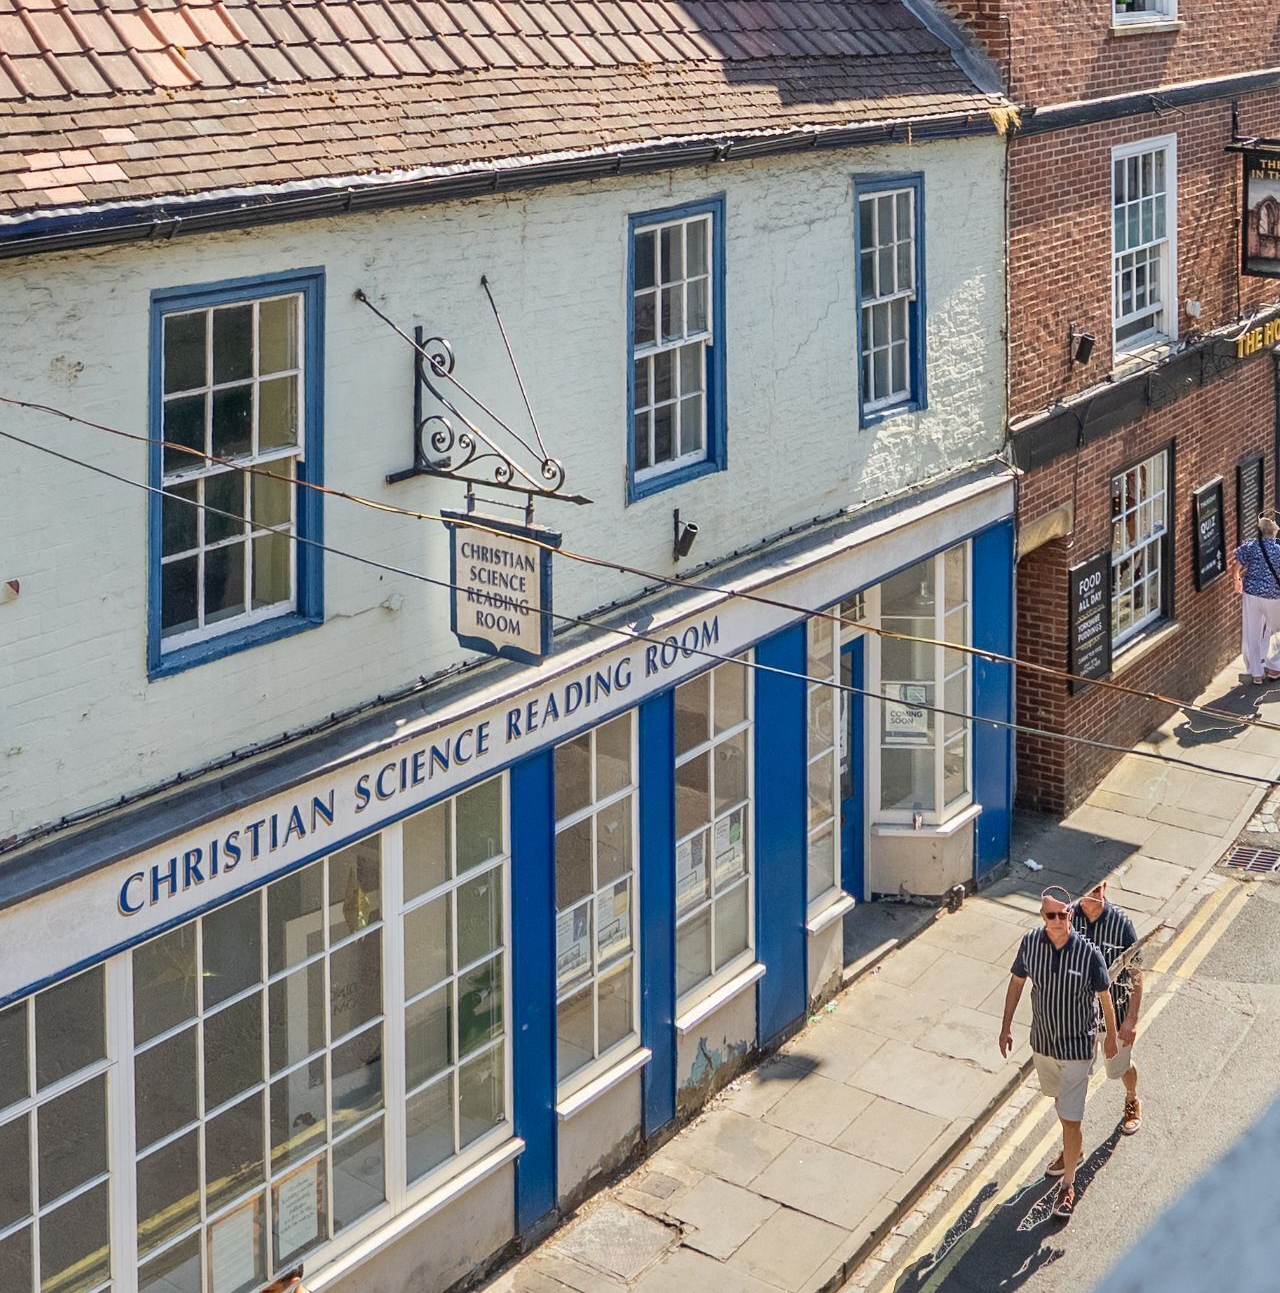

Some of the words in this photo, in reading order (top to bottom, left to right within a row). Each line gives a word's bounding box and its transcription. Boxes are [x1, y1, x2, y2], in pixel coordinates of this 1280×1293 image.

[1251, 170, 1265, 179] IN
[1236, 327, 1263, 358] THE
[1200, 515, 1216, 534] QUIZ
[461, 542, 535, 573] CHRISTIAN
[469, 566, 526, 593] SCIENCE
[1079, 572, 1101, 595] FOOD
[467, 587, 530, 616] READING
[1079, 599, 1090, 612] ALL
[1091, 590, 1102, 604] DAY
[476, 610, 521, 636] ROOM
[117, 789, 335, 917] CHRISTIAN
[354, 721, 490, 812] SCIENCE
[505, 658, 632, 742] READING
[644, 615, 720, 677] ROOM
